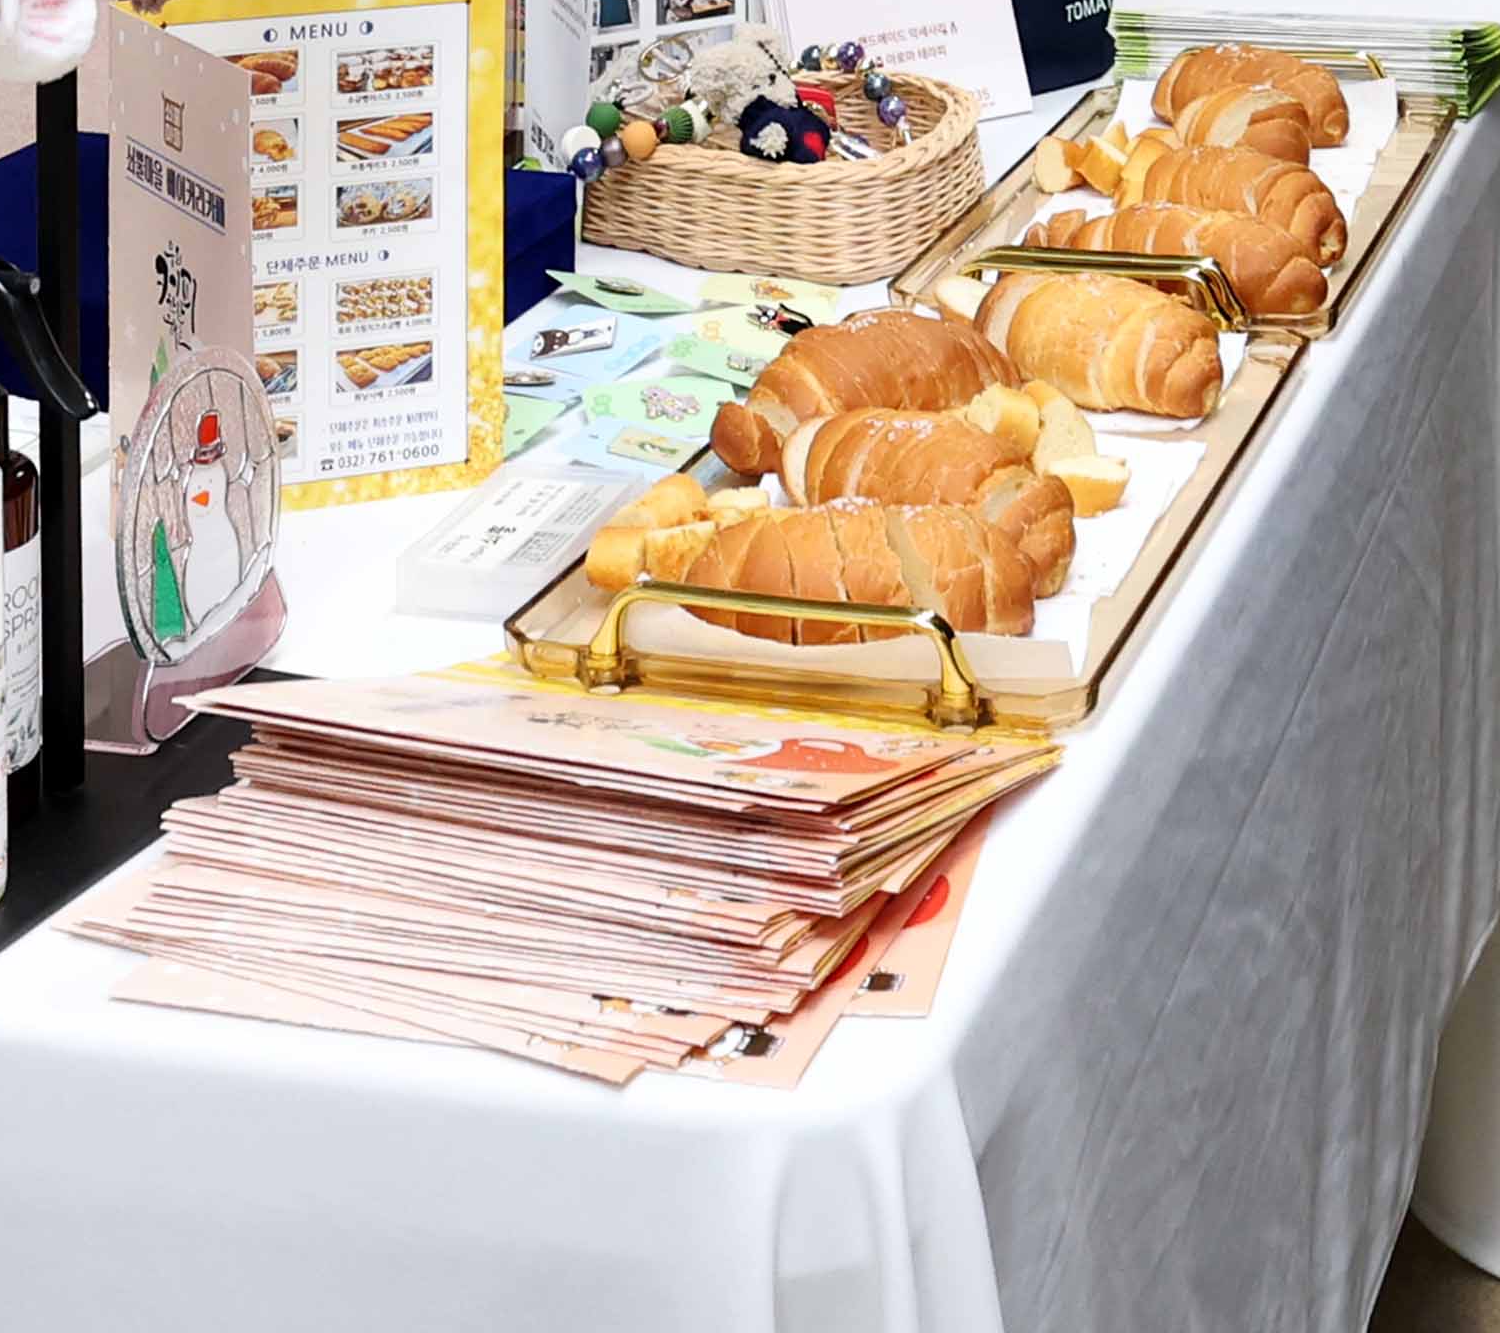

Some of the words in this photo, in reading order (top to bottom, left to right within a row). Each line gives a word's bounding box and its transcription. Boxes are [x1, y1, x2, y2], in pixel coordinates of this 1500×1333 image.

[290, 22, 348, 41] MENU
[266, 257, 320, 275] 단체주문
[325, 251, 369, 268] MENU
